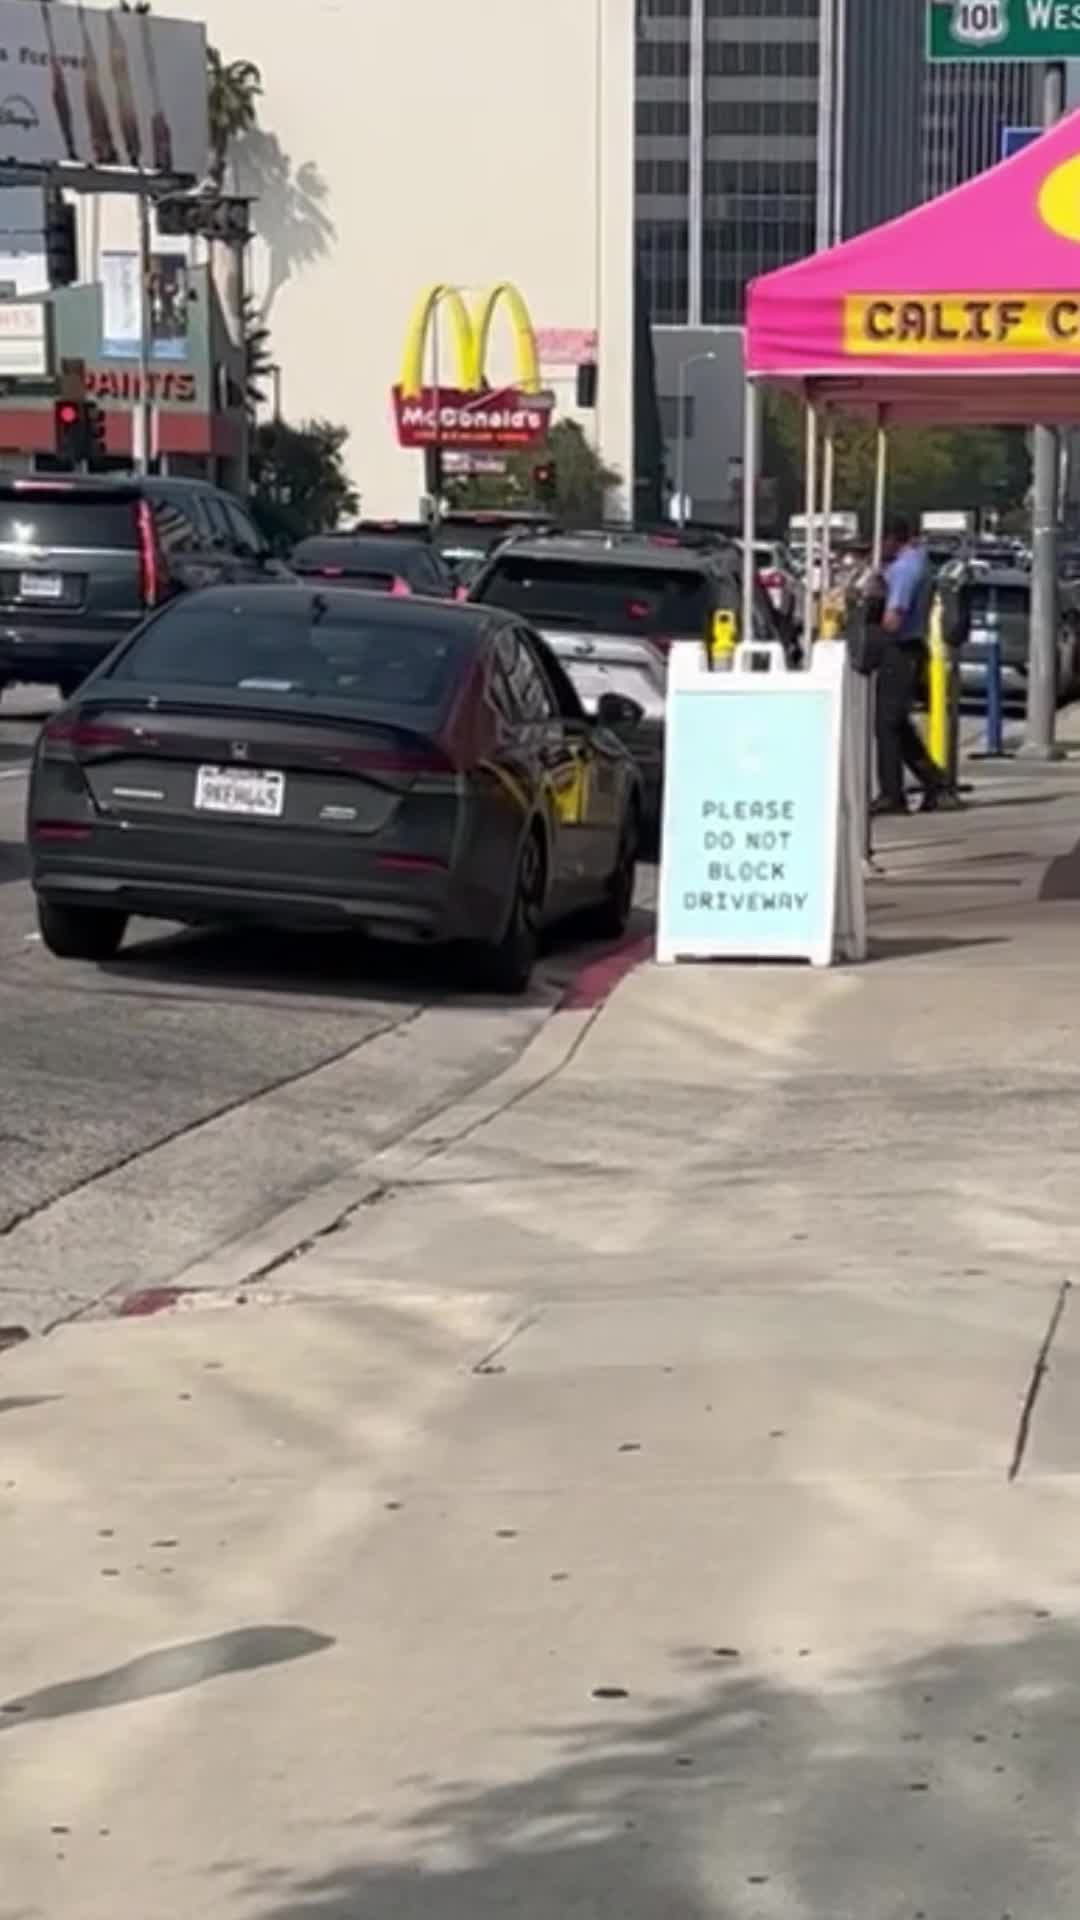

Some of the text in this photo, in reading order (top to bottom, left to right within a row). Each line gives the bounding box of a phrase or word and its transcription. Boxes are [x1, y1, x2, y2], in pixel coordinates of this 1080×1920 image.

[961, 4, 998, 30] 101
[865, 301, 1027, 341] CALIF
[401, 405, 541, 430] McDonald's
[702, 800, 795, 820] PLEASE
[704, 830, 792, 850] DO NOT
[707, 860, 785, 881] BLOCK
[683, 890, 809, 911] DRIVEWAY
